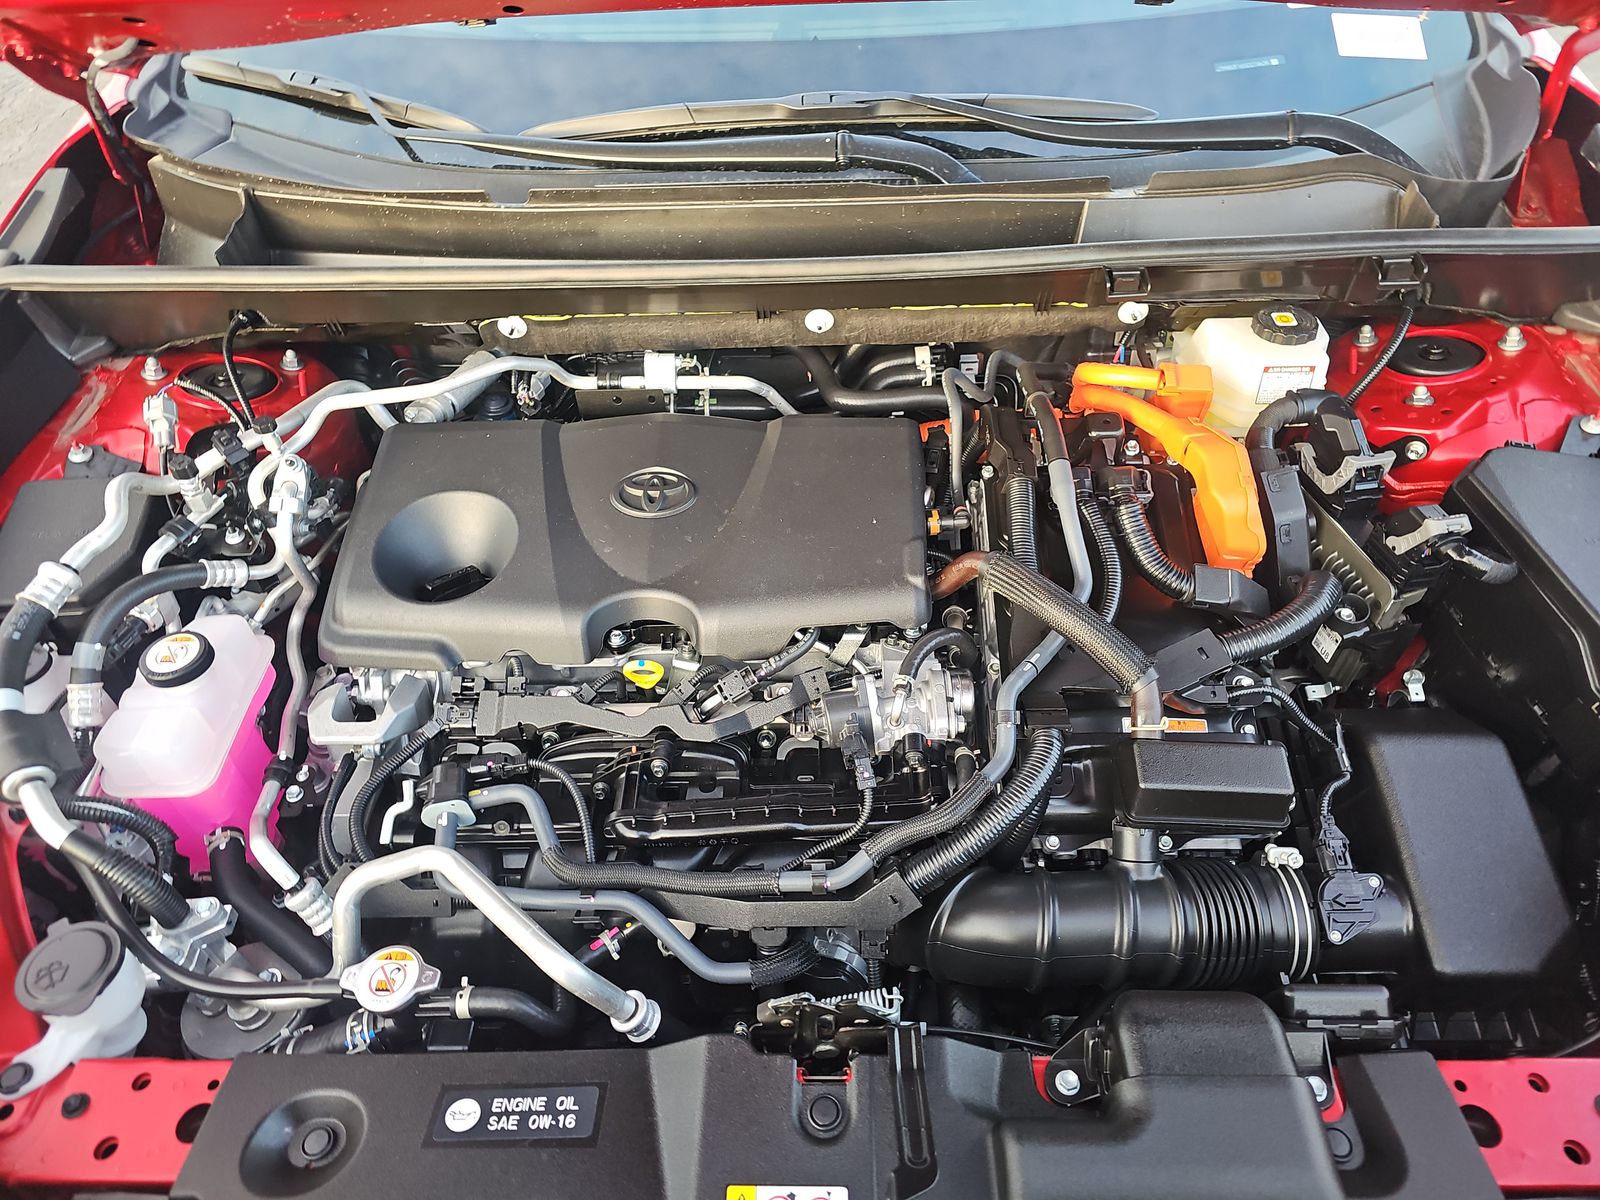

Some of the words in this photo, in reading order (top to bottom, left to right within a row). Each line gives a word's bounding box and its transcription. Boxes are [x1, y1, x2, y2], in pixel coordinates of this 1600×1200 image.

[491, 1097, 547, 1112] ENGINE
[556, 1096, 579, 1111] OIL
[487, 1115, 520, 1130] SAE
[528, 1114, 576, 1130] 0W-16
